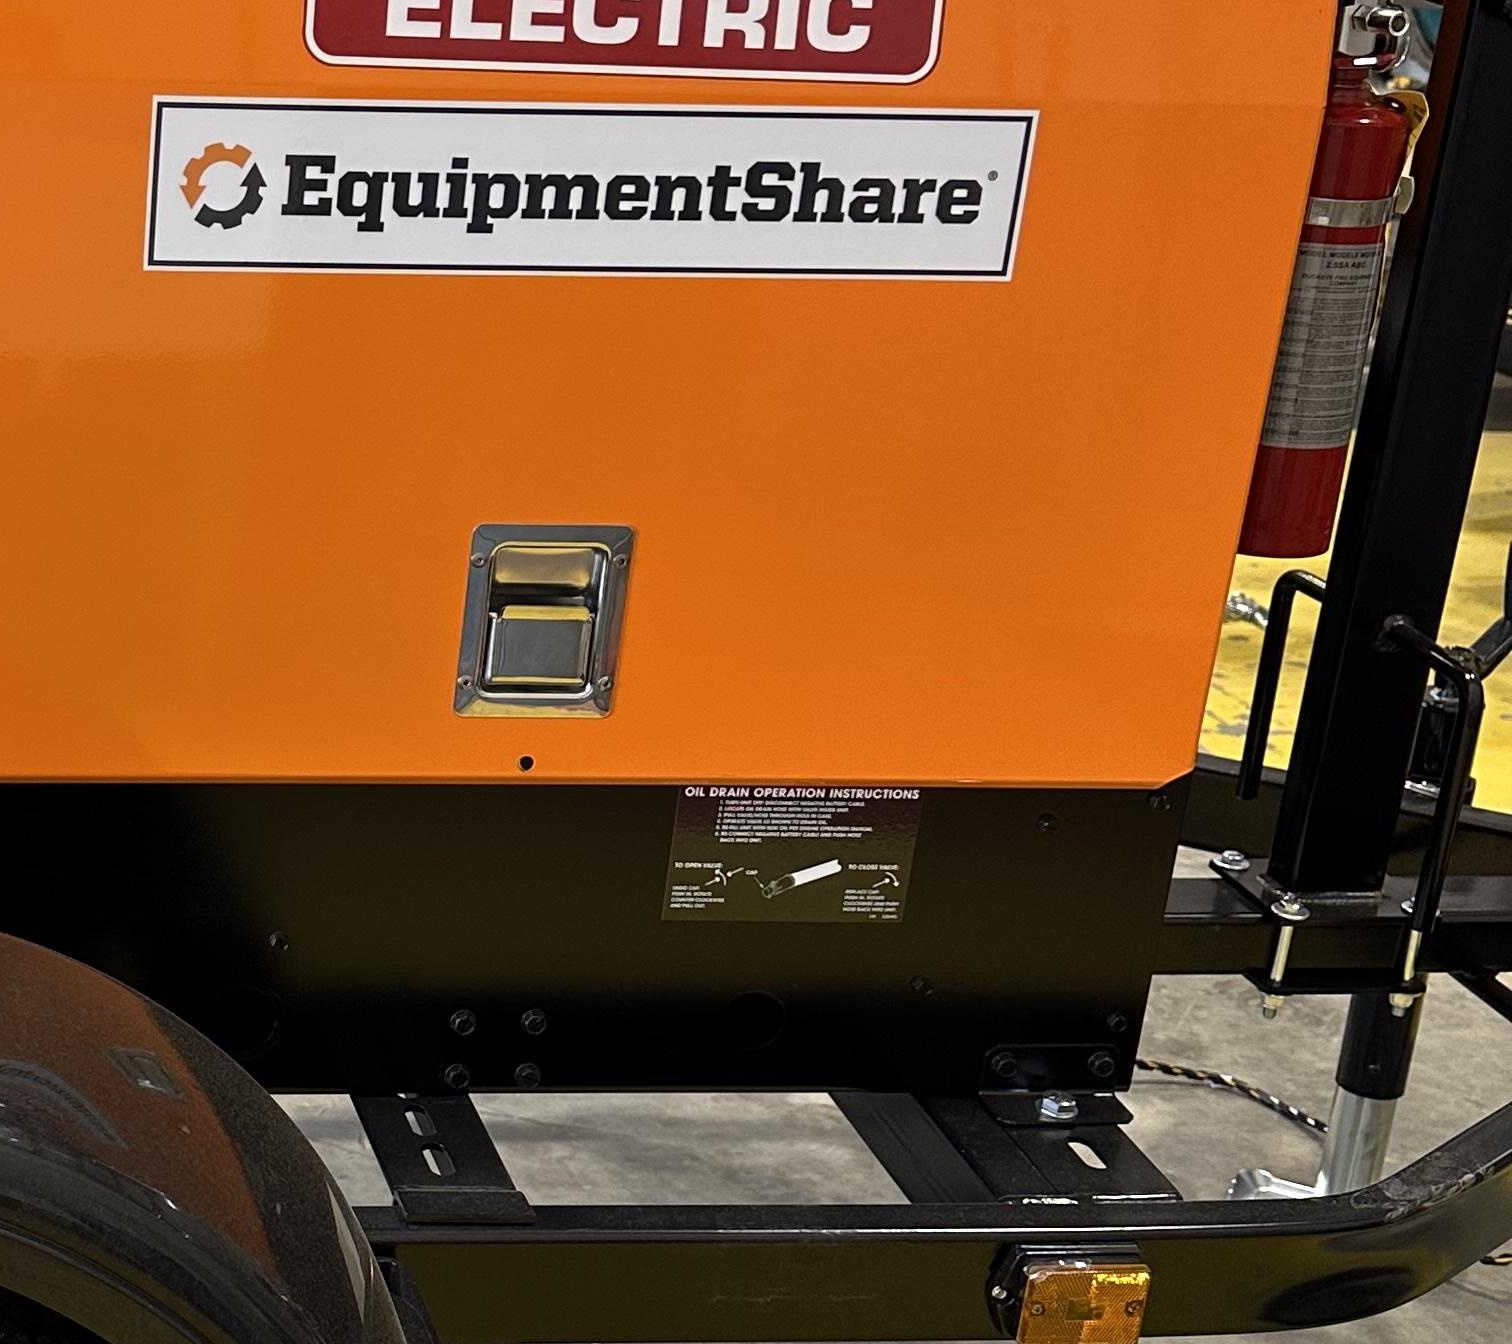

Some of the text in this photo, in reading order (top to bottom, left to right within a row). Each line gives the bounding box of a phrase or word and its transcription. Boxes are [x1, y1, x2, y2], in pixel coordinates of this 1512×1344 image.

[281, 153, 986, 234] EquipmentShare
[685, 787, 920, 800] OIL DRAIN OPERATION INSTRUCTIONS
